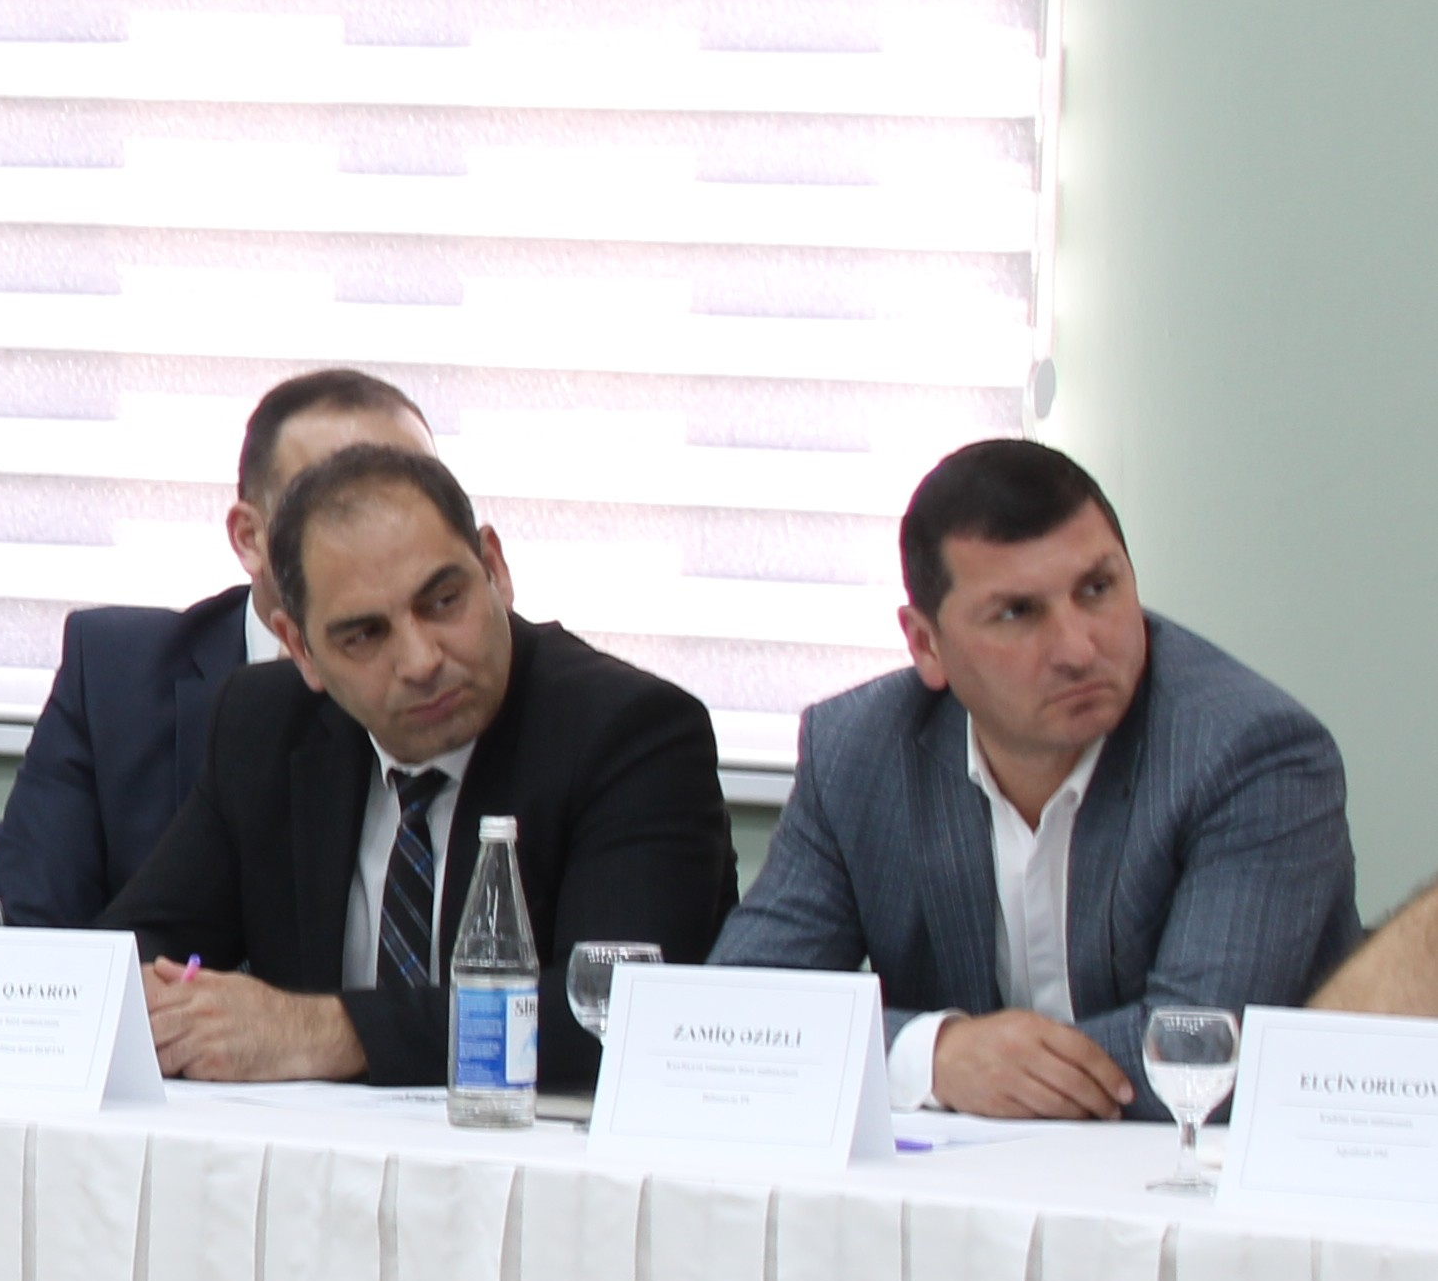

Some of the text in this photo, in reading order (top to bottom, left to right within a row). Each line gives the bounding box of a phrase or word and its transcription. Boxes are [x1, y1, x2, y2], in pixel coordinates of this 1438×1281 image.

[2, 981, 83, 1001] QAFAROV
[672, 1023, 802, 1049] ZAMİQ ƏZİZLİ
[1300, 1070, 1356, 1095] ELÇİN
